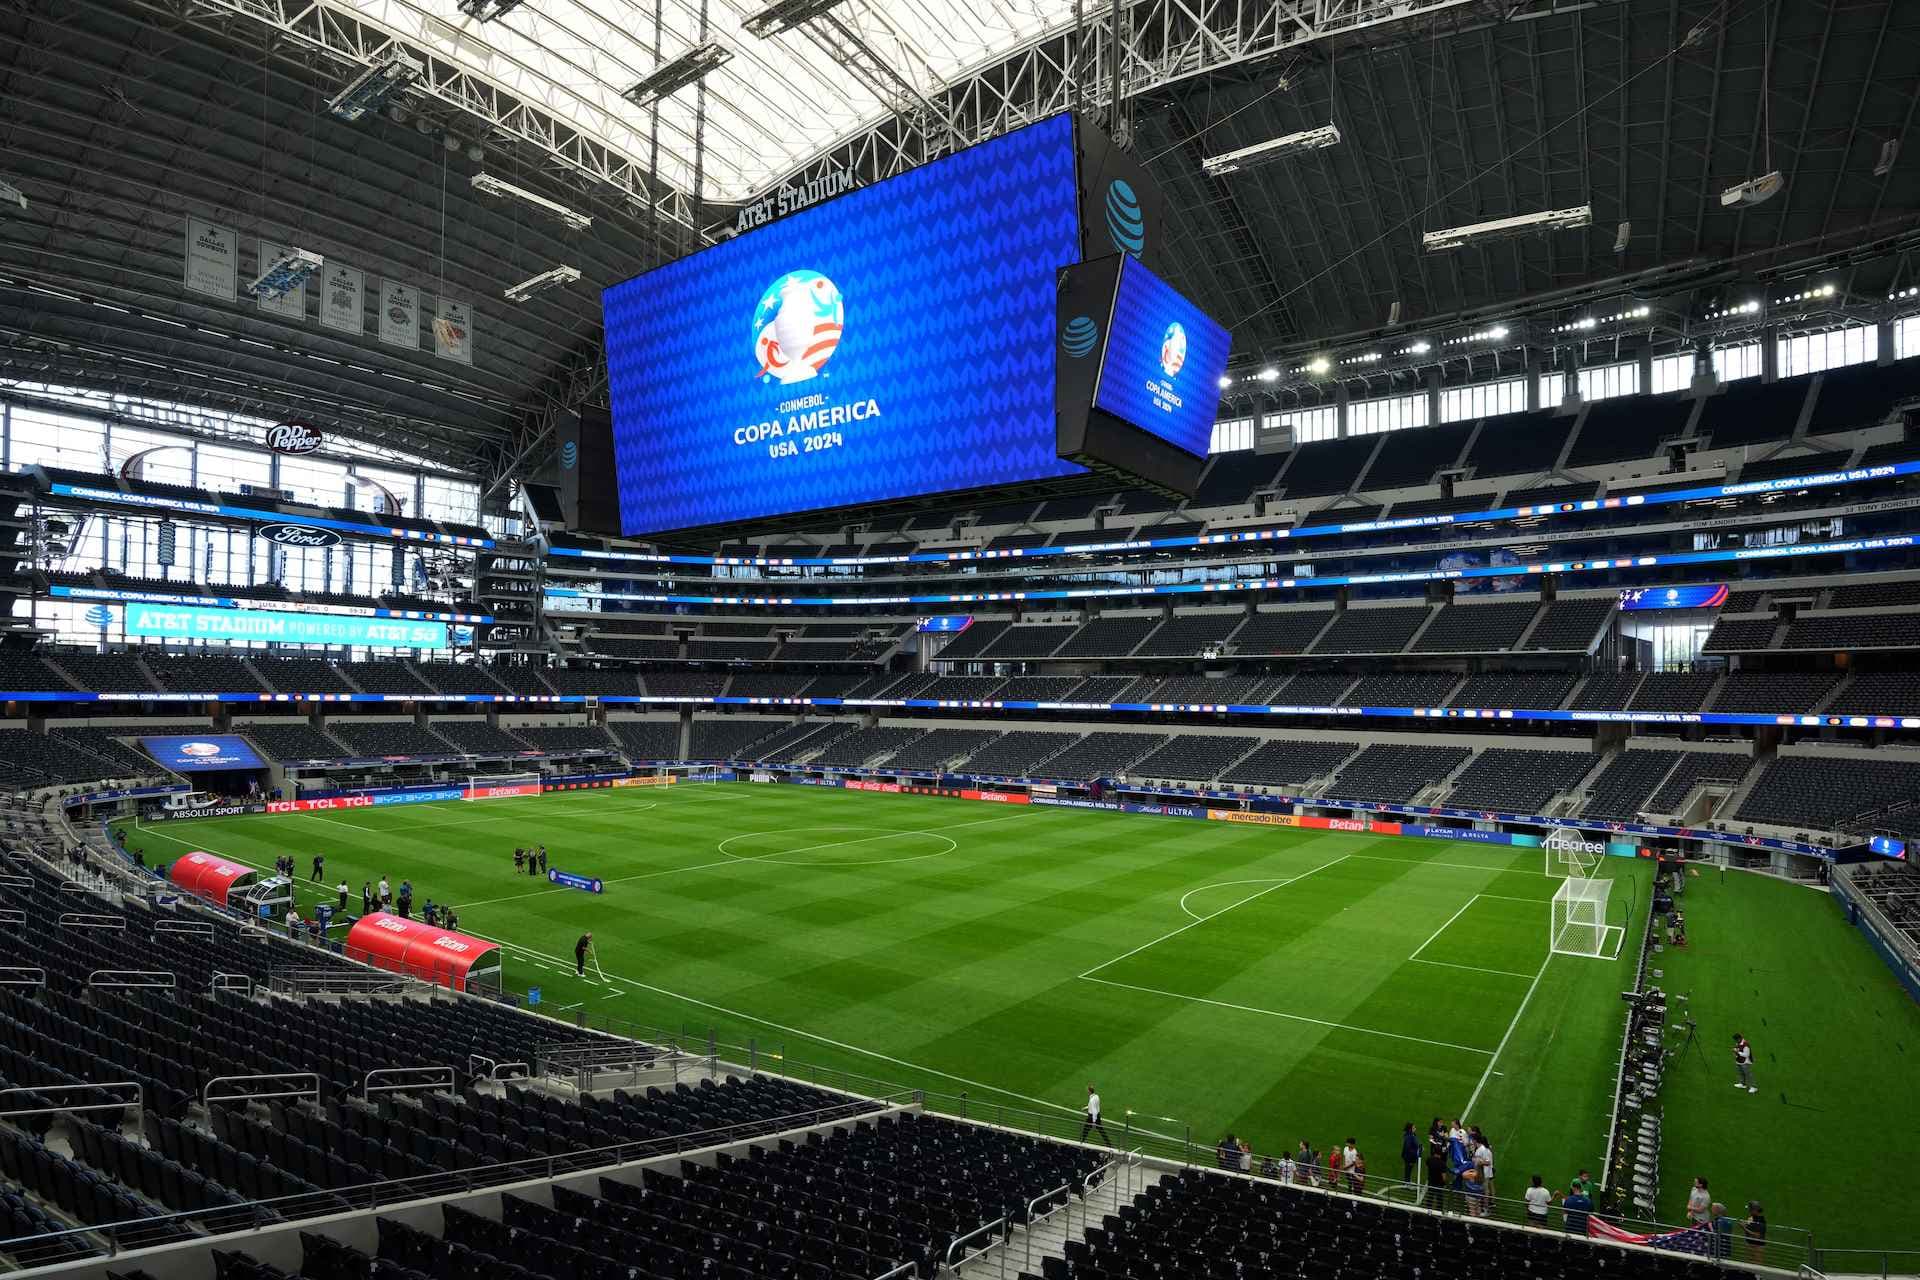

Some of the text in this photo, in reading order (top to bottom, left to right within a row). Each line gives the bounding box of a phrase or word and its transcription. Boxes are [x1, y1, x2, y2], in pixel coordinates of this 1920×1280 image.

[736, 166, 855, 232] AT&T STADIUM
[1146, 380, 1182, 408] COPA AMERICA
[734, 398, 881, 445] COPA AMERICA
[269, 425, 322, 450] Pepper
[293, 425, 311, 437] Dr
[768, 432, 843, 458] USA 2024
[1721, 466, 1896, 495] CONMEBOL COPA AMERICA USA 2024
[71, 487, 121, 500] CONMEBOL
[122, 494, 145, 504] COPA
[145, 497, 183, 508] AMERICA
[274, 525, 327, 546] Ford
[1736, 537, 1913, 559] CONMEBOL COPA AMERICA USA 2024
[70, 587, 120, 599] CONMEBOL
[122, 591, 145, 601] COPA
[144, 593, 182, 603] AMERICA
[136, 611, 440, 641] AT&T STADIUM POWERED BY AT&T 5G
[1611, 713, 1632, 721] COPA
[750, 774, 769, 783] PUMA
[406, 793, 432, 802] BYD
[488, 787, 520, 796] Betano
[981, 791, 1008, 802] Betano
[267, 801, 299, 812] TCL
[306, 799, 337, 809] TCL
[344, 796, 373, 806] TCL
[172, 807, 214, 819] ABSOLUT
[215, 806, 245, 816] SPORT
[1168, 807, 1193, 817] ULTRA
[1231, 813, 1292, 824] mercado libre
[1552, 839, 1604, 854] Degree
